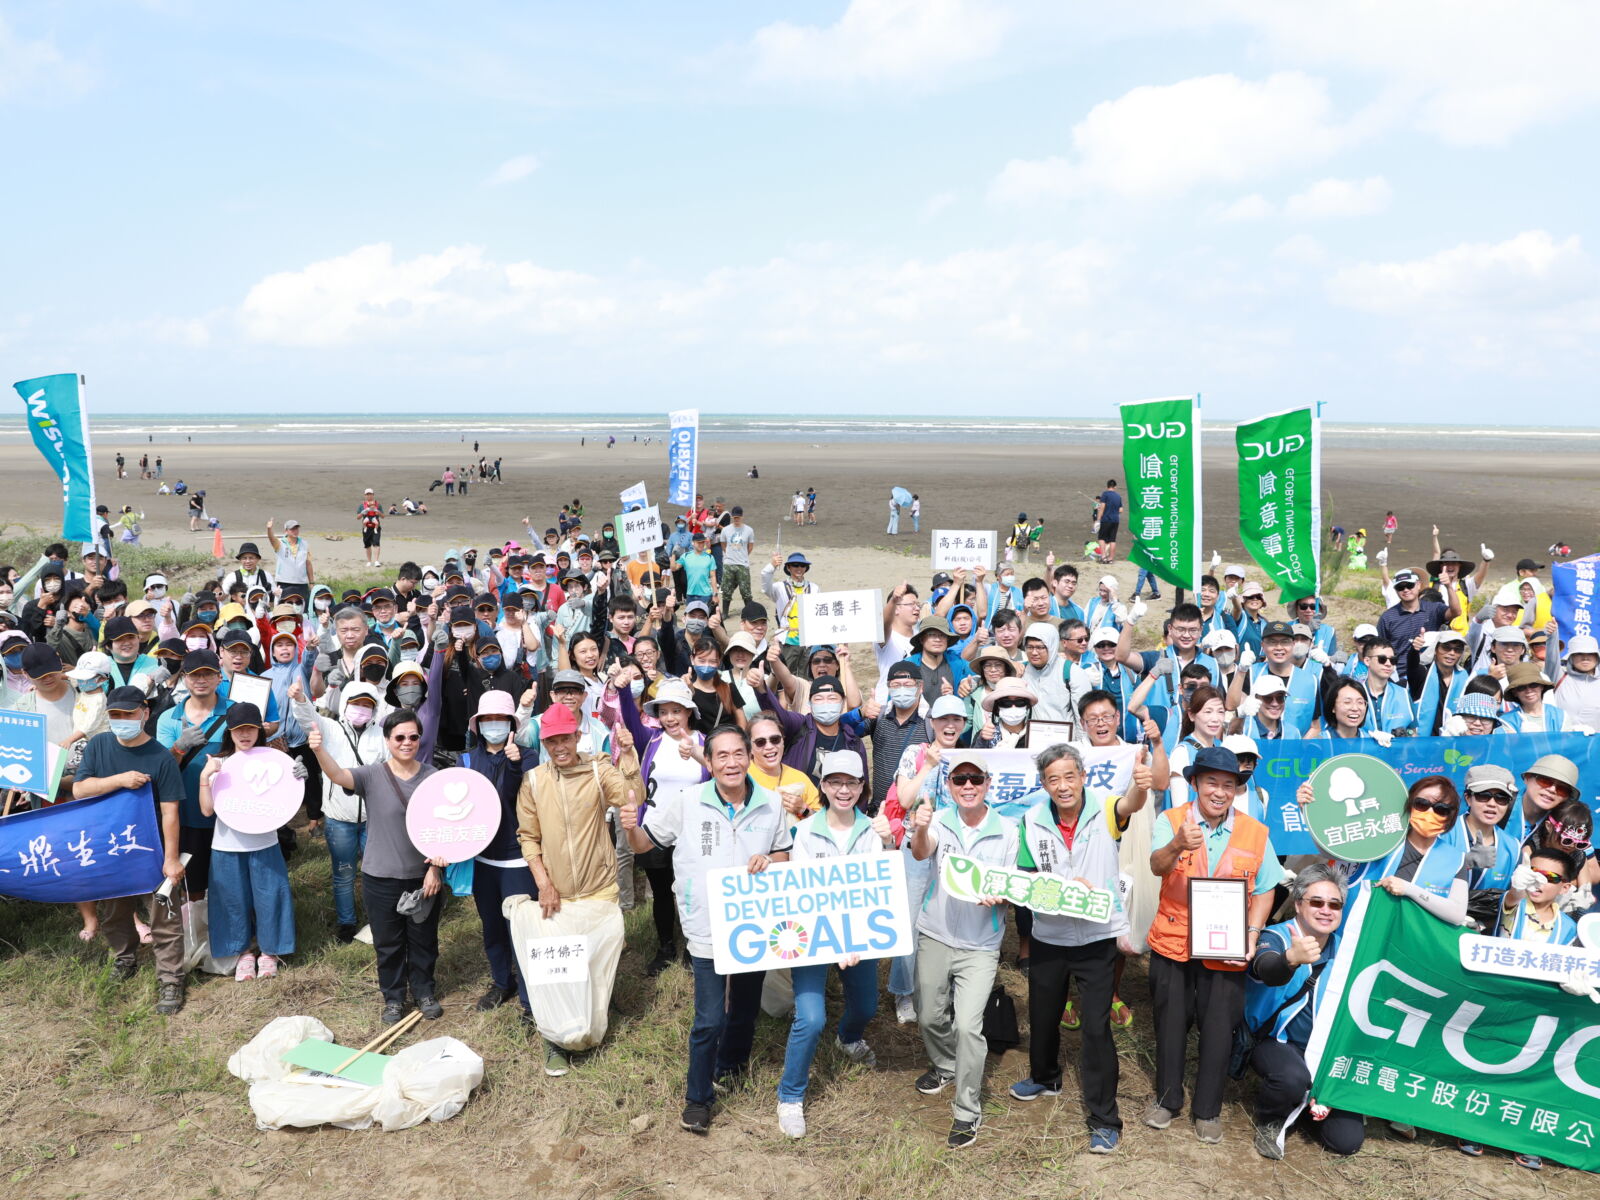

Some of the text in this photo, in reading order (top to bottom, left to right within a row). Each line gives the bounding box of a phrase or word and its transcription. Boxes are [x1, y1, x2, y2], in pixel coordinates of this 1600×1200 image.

[625, 515, 660, 534] 新竹佛
[939, 536, 988, 549] 高平磊晶
[815, 599, 862, 617] 酒醬丰
[1266, 758, 1331, 779] GU
[1404, 763, 1445, 775] Service
[419, 825, 489, 845] 幸福友善
[1323, 813, 1404, 847] 宜居永續
[0, 824, 155, 877] 鼎生技
[721, 859, 892, 897] SUSTAINABLE
[724, 886, 893, 922] DEVELOPMENT
[982, 869, 1112, 920] 淨零綠生活
[728, 909, 898, 965] GOALS
[530, 943, 585, 961] 新竹佛子
[1328, 1055, 1596, 1148] 創意電子股份有限公
